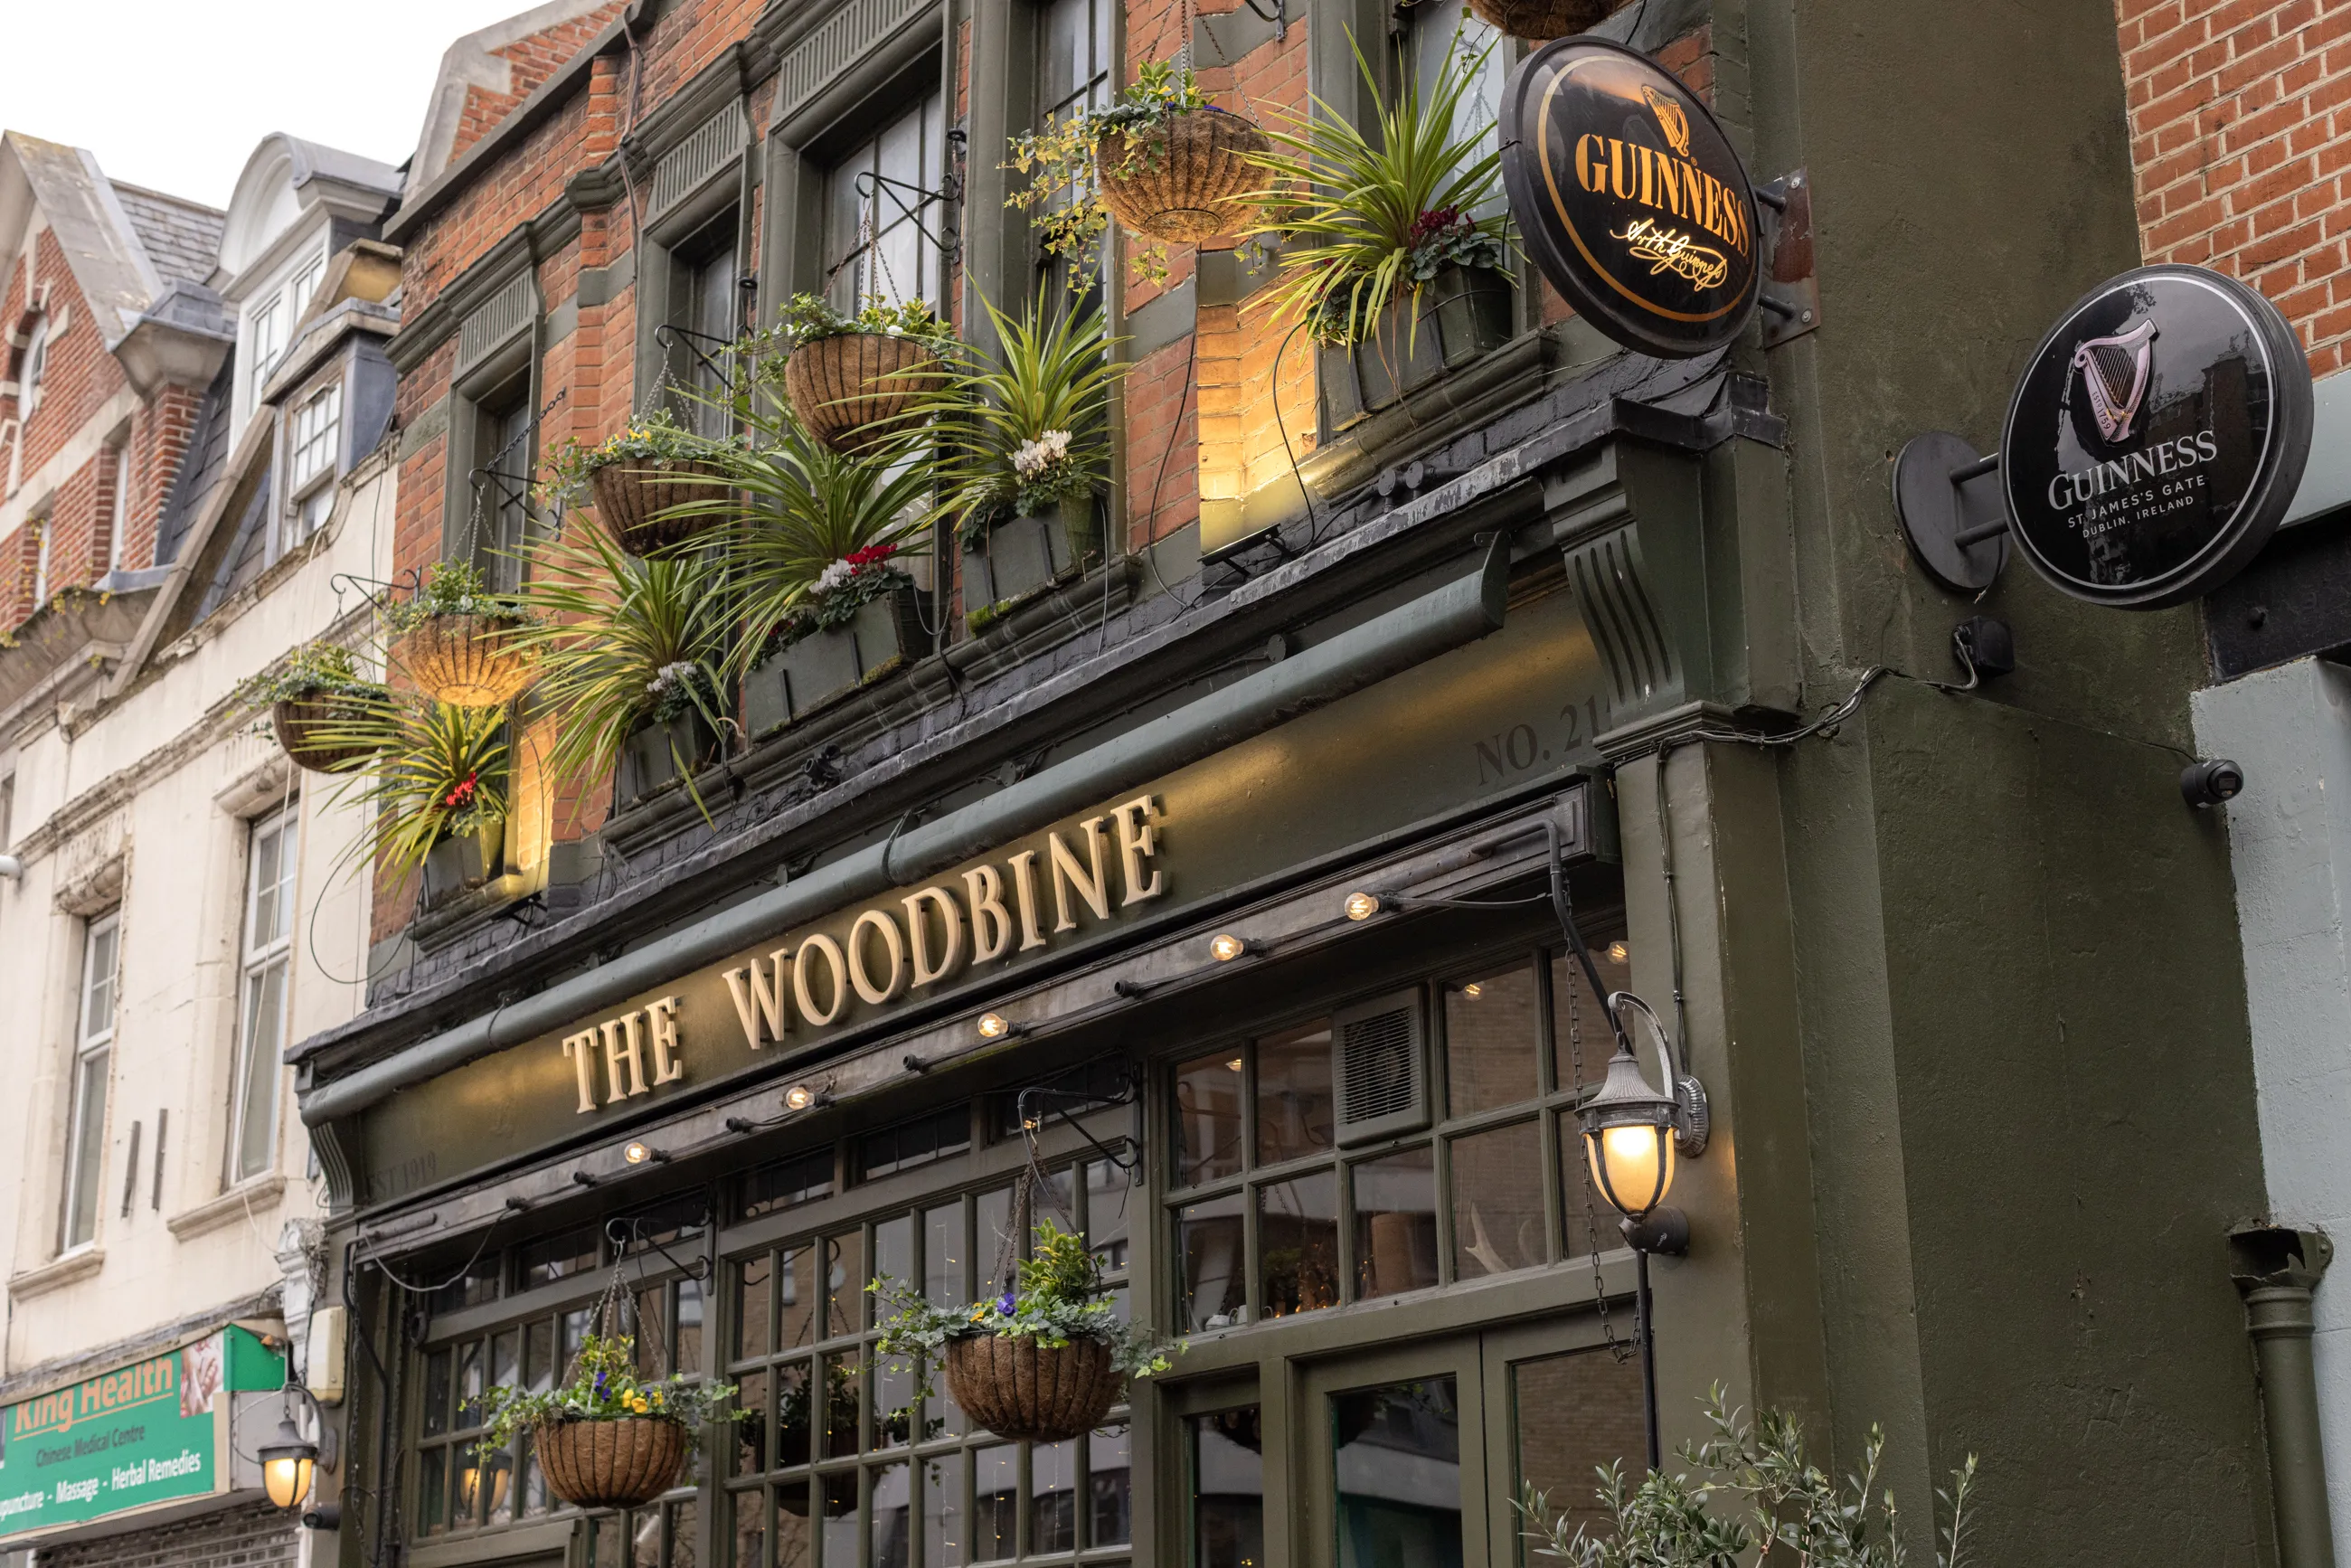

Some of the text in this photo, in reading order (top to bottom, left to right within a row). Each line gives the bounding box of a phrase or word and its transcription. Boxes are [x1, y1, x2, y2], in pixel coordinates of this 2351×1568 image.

[1575, 133, 1750, 258] GUINNESS
[2098, 408, 2111, 430] 1759
[2048, 430, 2217, 511] GUINNESS
[2068, 475, 2205, 528] ST JAMES'S GATE
[2137, 496, 2194, 520] IRELAND
[1473, 694, 1612, 787] NO. 21
[562, 794, 1163, 1114] THE WOODBINE
[14, 1356, 173, 1432] King Health
[36, 1425, 145, 1468] Chinese Medical Centre
[55, 1478, 99, 1503] Massage
[111, 1459, 146, 1490] Herbal
[148, 1449, 201, 1482] Remedies
